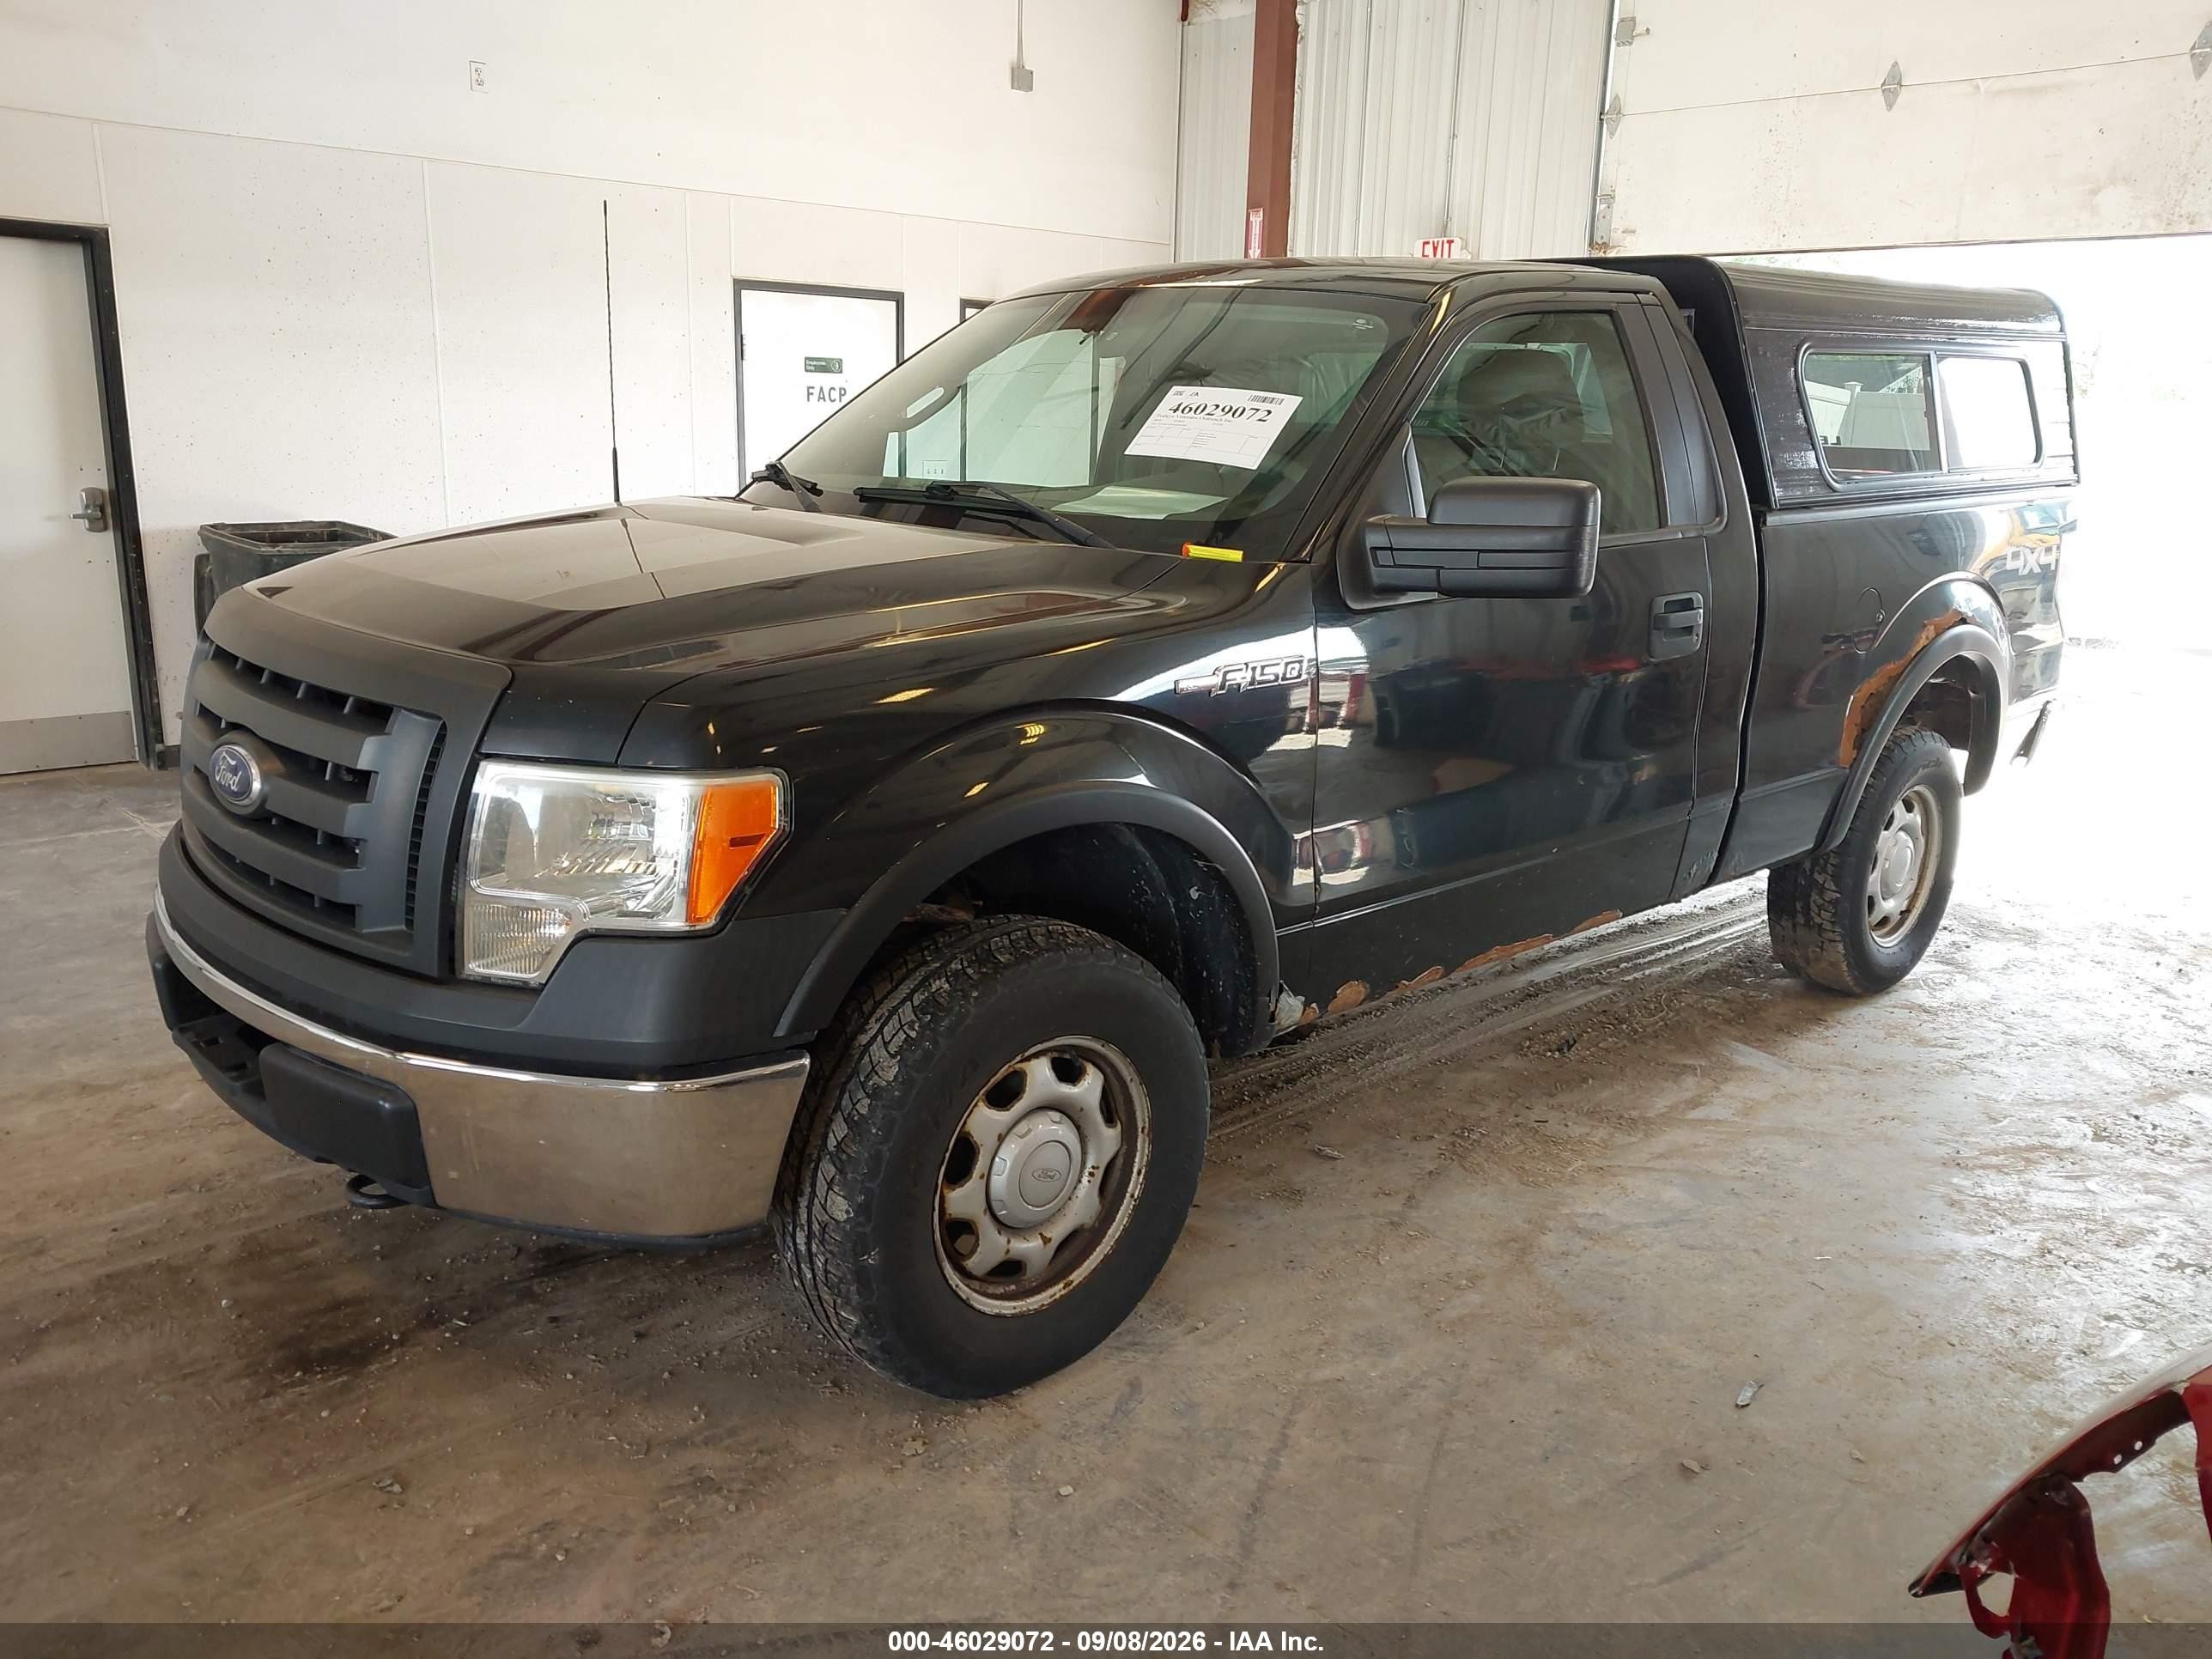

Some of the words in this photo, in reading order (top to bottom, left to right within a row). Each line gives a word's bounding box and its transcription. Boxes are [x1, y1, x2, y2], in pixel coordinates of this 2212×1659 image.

[806, 386, 847, 403] FACP
[1169, 401, 1273, 422] 46029072
[215, 750, 241, 792] Ford
